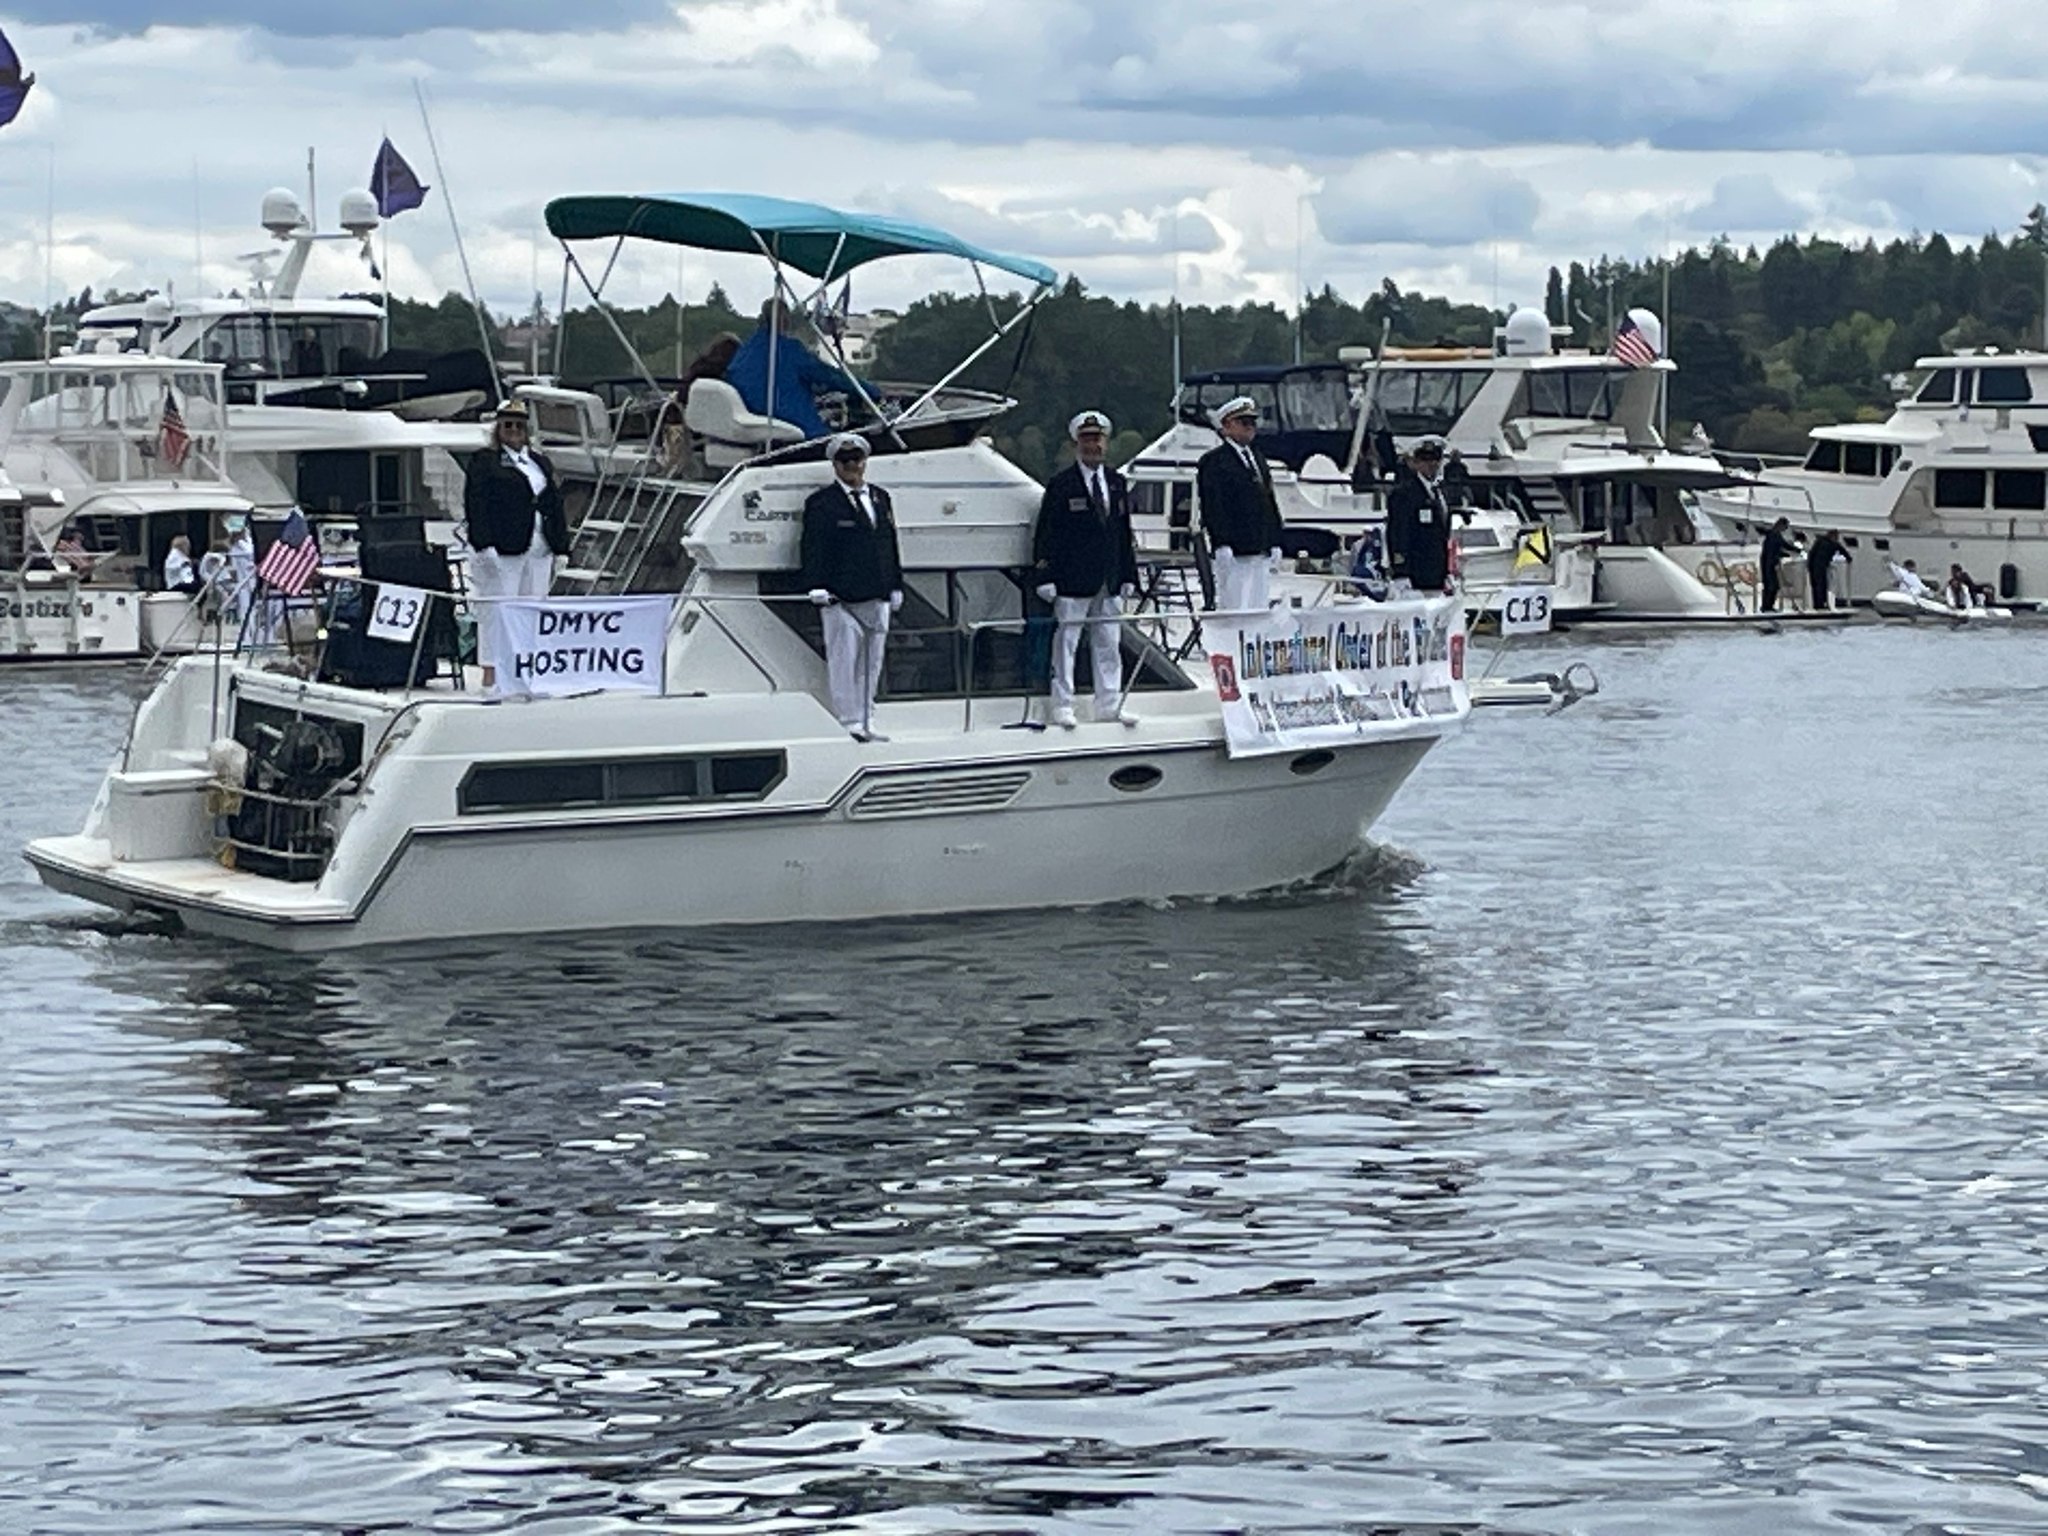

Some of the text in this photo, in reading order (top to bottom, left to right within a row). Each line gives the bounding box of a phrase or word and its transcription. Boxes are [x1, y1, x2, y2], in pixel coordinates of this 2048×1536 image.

[376, 596, 418, 628] C13
[539, 611, 624, 635] DMYC
[1506, 595, 1547, 624] C13
[515, 648, 644, 679] HOSTING
